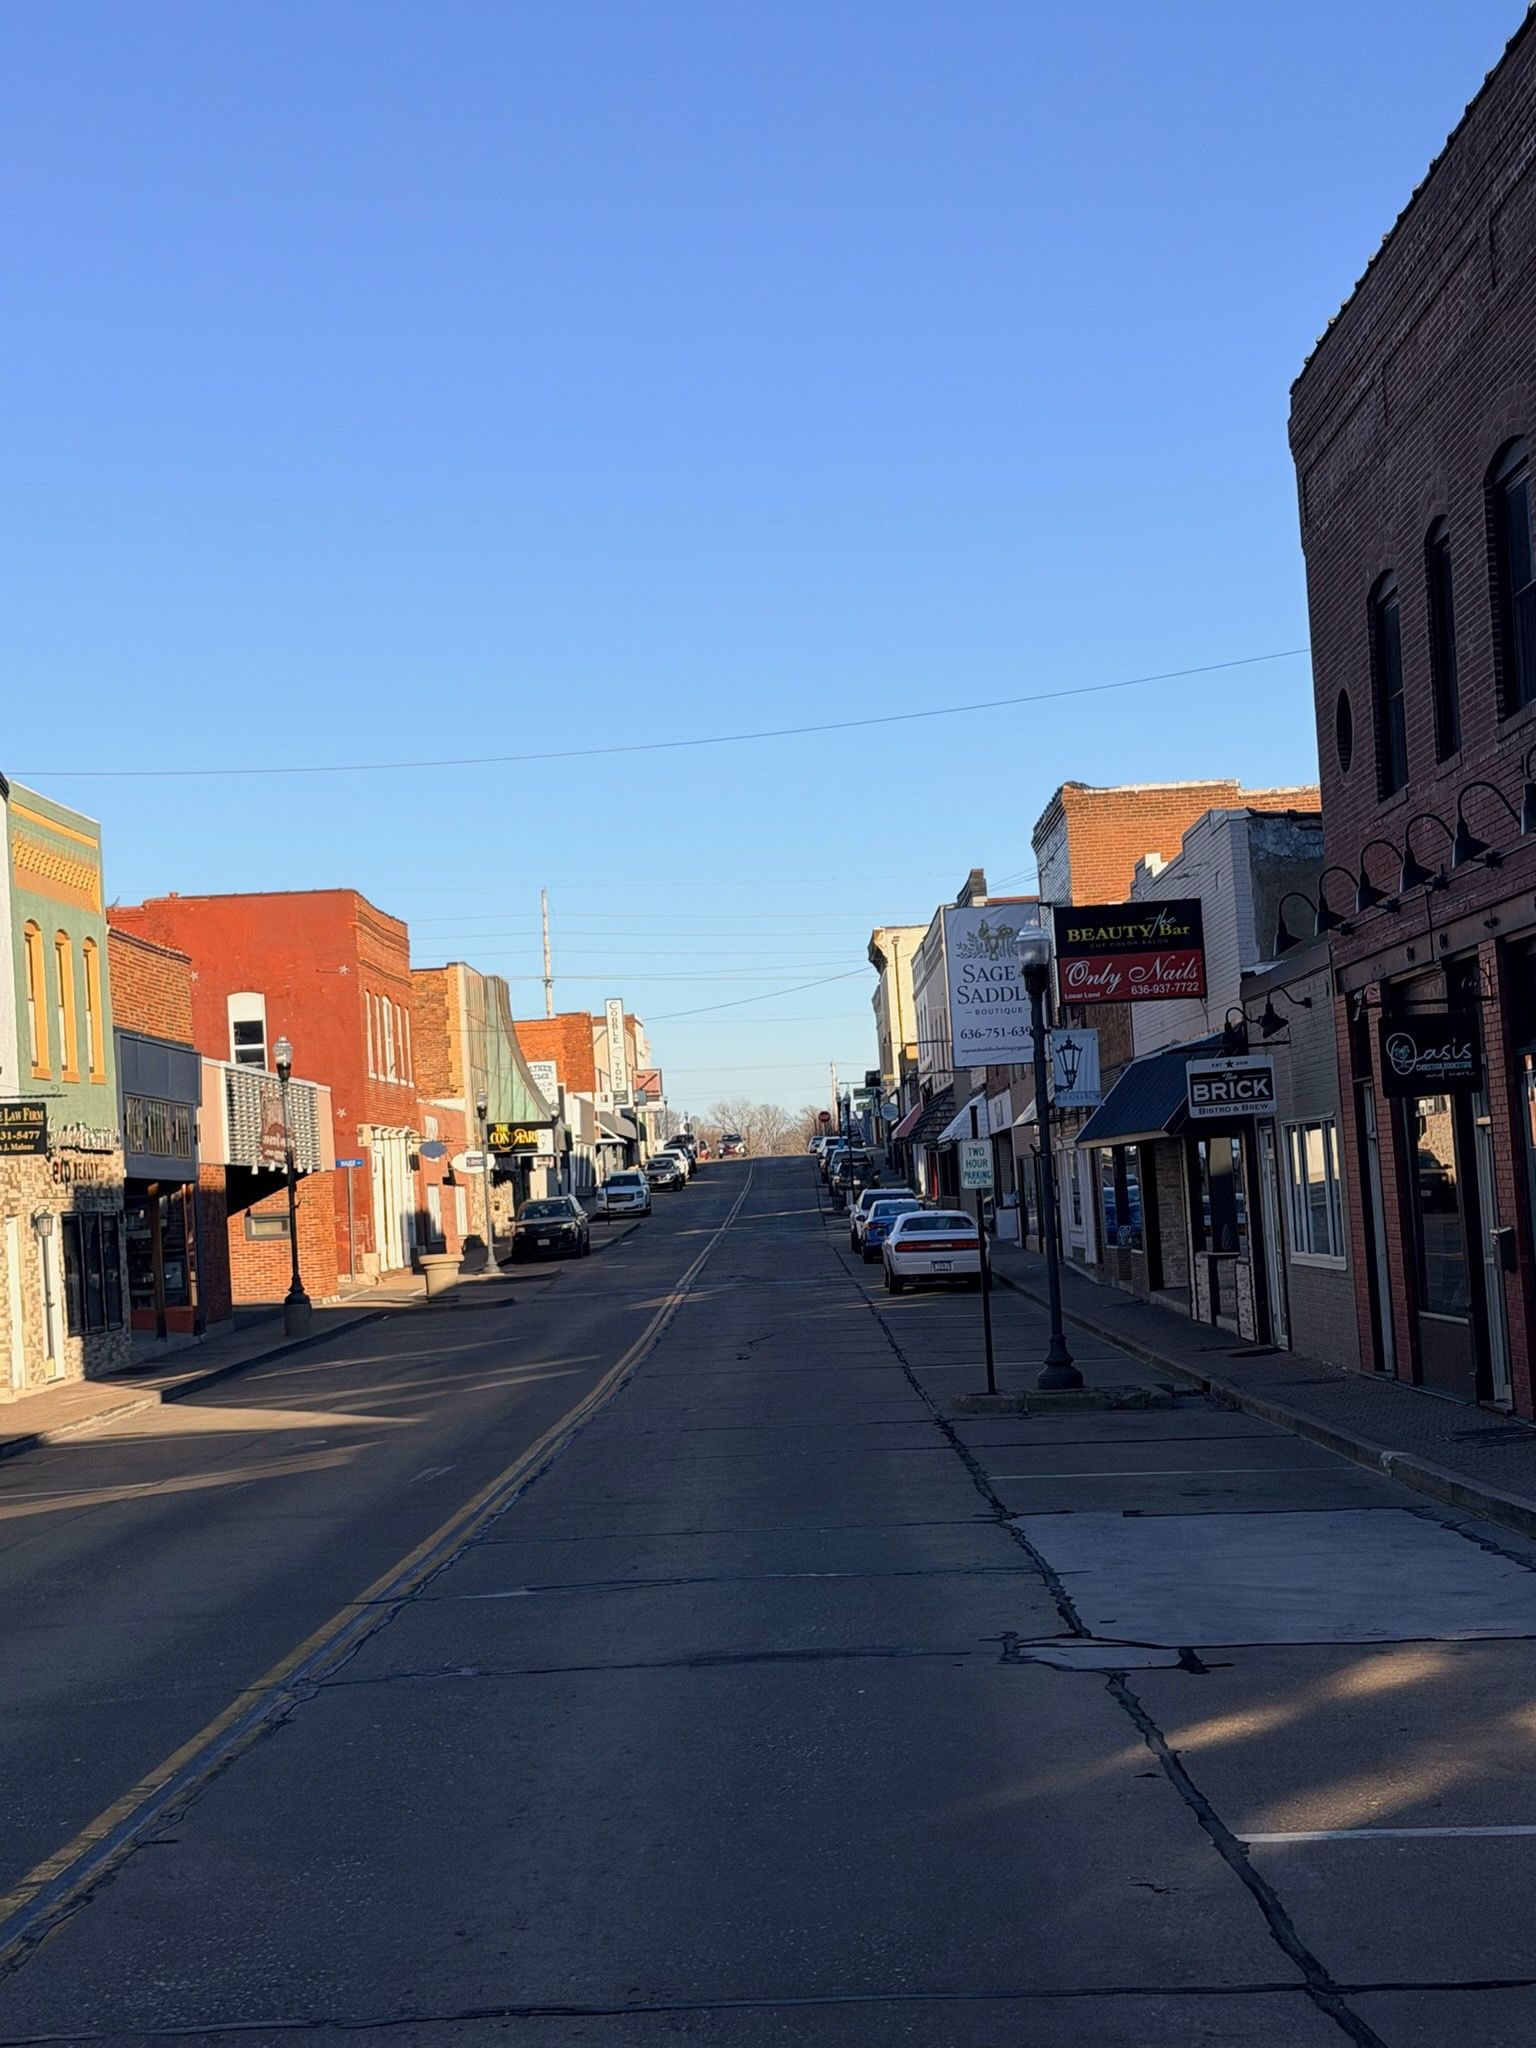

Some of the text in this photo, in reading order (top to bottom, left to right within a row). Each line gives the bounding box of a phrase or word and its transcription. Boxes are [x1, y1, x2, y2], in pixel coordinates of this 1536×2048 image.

[1067, 924, 1190, 943] BEAUTY Bar
[963, 964, 1015, 984] SAGE
[1065, 955, 1198, 994] Only Nails
[1131, 982, 1199, 995] 636-937-7722
[1065, 992, 1083, 1000] Lower
[975, 1007, 1023, 1016] BOUTIQUE
[1386, 1032, 1472, 1075] Oasis
[1222, 1072, 1238, 1081] The
[1193, 1078, 1270, 1102] BRICK
[4, 1108, 22, 1121] LAW
[23, 1107, 44, 1121] FIRM
[1198, 1106, 1231, 1115] BISTRO
[968, 1147, 985, 1156] TWO
[965, 1159, 988, 1168] HOUR
[964, 1170, 992, 1179] PARKING
